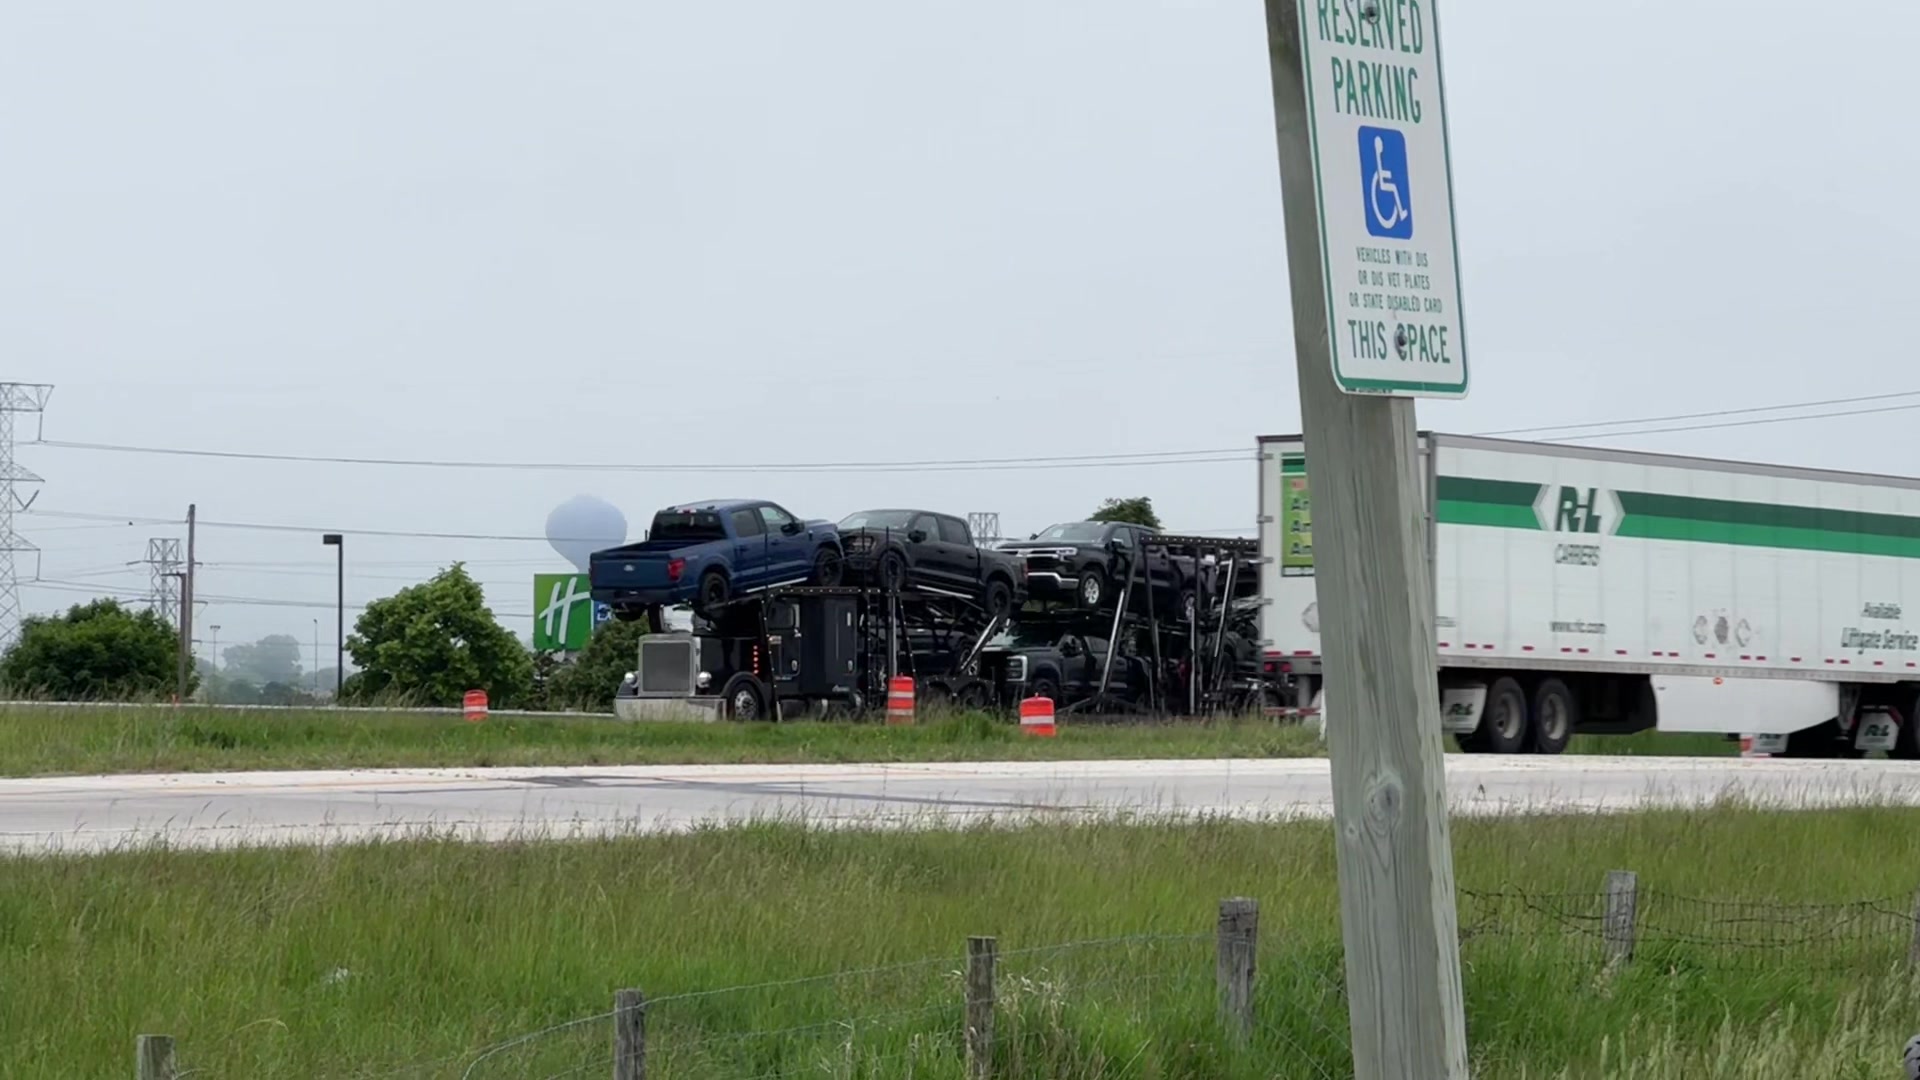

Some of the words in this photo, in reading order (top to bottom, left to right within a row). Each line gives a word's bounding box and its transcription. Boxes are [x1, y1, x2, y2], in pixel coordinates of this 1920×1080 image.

[1317, 0, 1423, 54] RESERVED
[1331, 56, 1421, 124] PARKING
[1356, 247, 1391, 264] VEHICLES
[1395, 250, 1413, 267] WITH
[1416, 252, 1428, 268] DIS
[1358, 269, 1368, 286] OR
[1371, 271, 1384, 287] DIS
[1387, 272, 1400, 288] VET
[1405, 273, 1430, 290] PLATES
[1349, 292, 1359, 308] OR
[1363, 293, 1384, 309] STATE
[1387, 295, 1420, 313] DISABLED
[1424, 297, 1443, 313] CARD
[1348, 319, 1388, 360] THIS
[1882, 629, 1919, 651] Service
